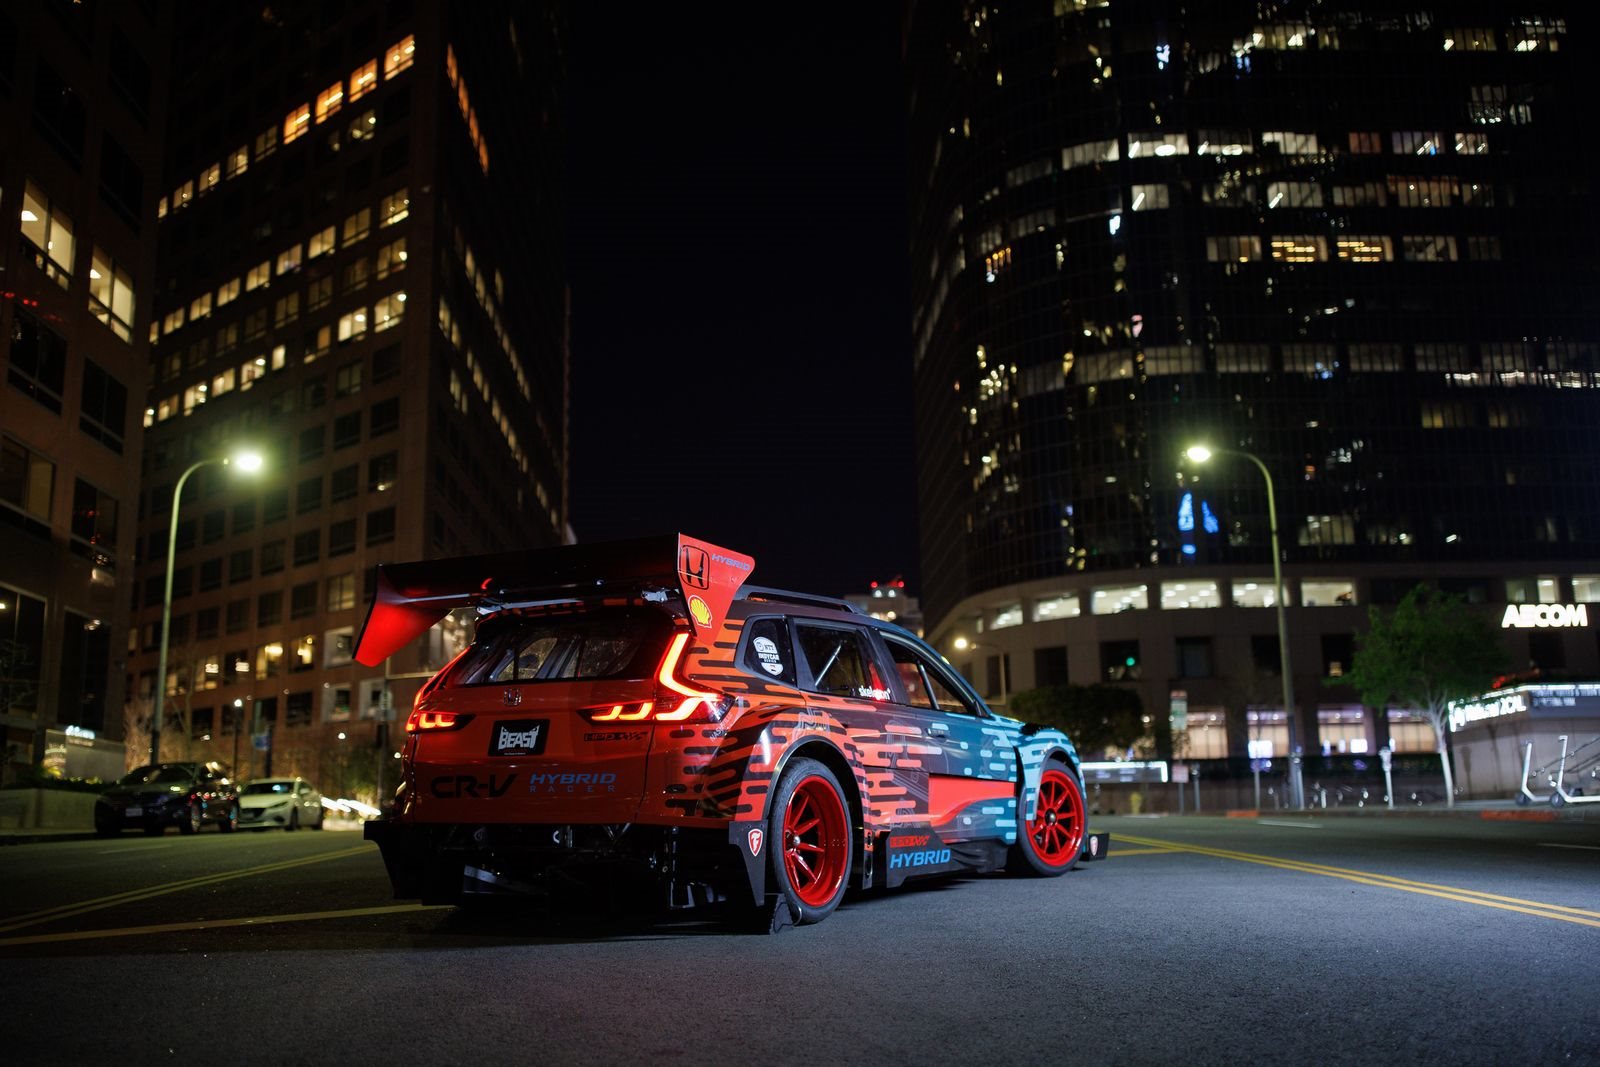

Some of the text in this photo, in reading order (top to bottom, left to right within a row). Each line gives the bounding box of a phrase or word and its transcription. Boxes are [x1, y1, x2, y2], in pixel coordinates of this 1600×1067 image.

[711, 553, 751, 571] HYBRID
[498, 725, 540, 750] BEAST
[431, 773, 520, 799] CR-V
[529, 773, 617, 784] HYBRID
[890, 849, 951, 869] HYBRID
